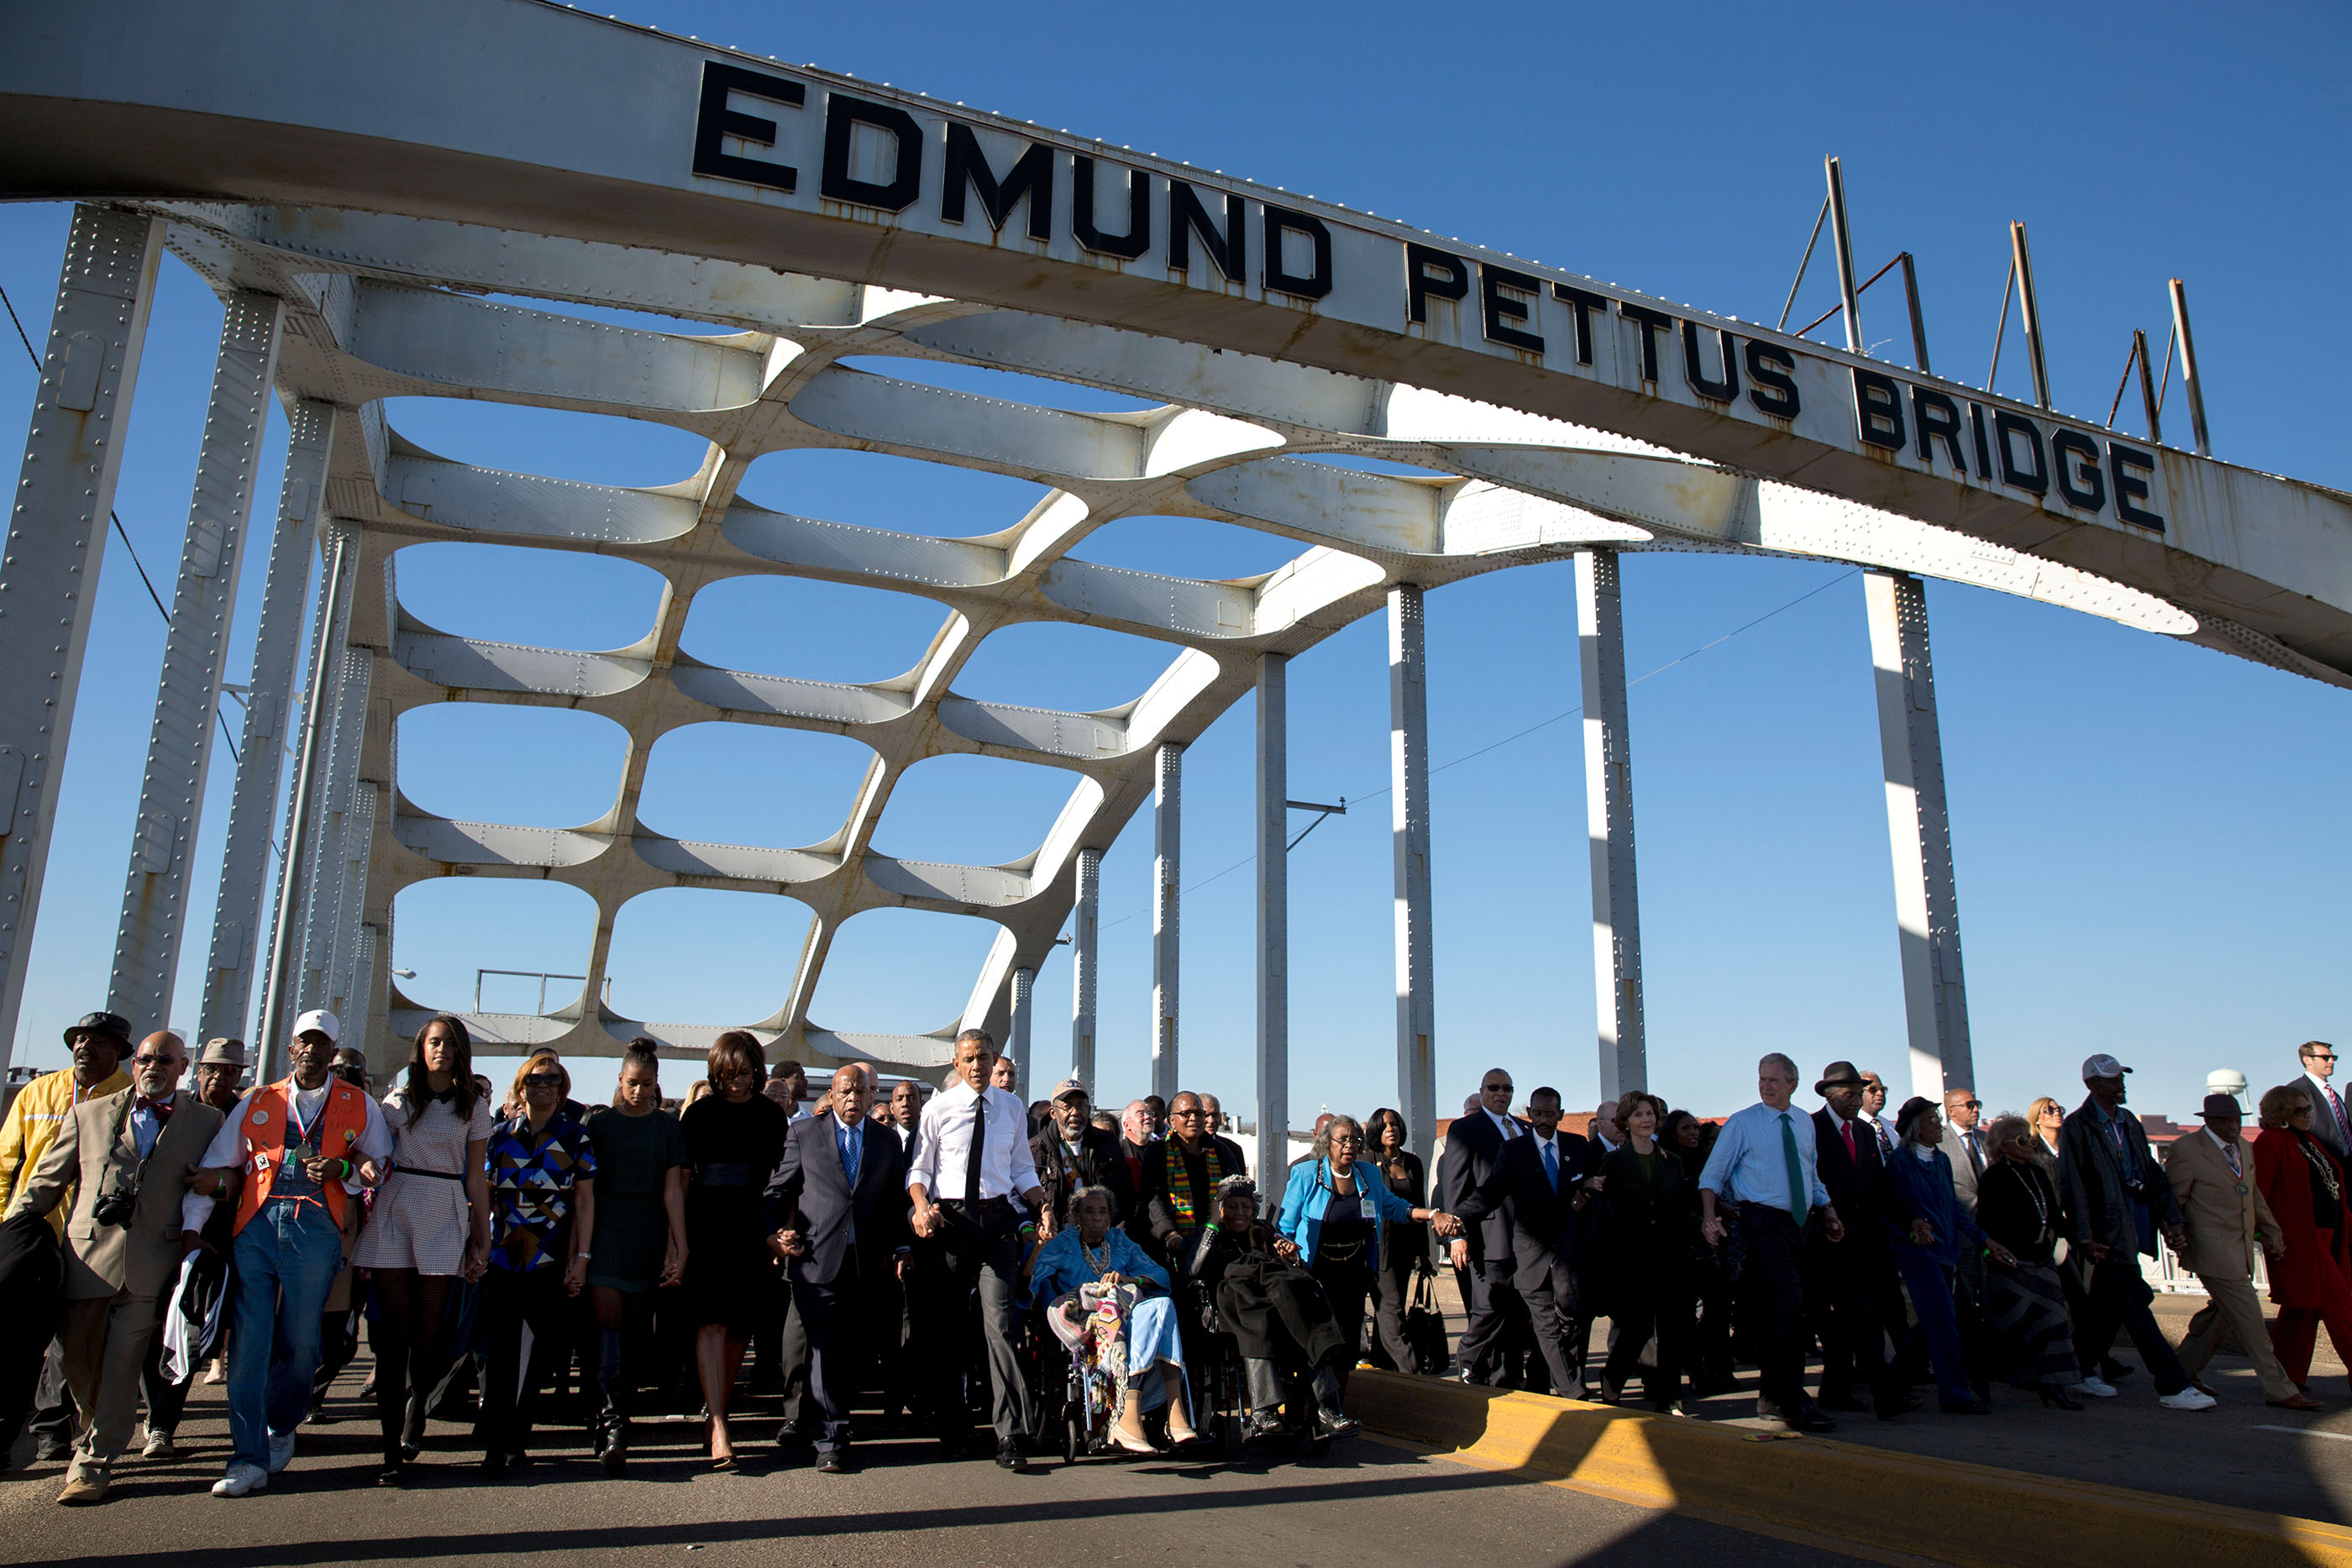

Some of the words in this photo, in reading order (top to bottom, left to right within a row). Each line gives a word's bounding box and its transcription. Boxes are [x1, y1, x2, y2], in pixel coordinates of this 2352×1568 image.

[692, 60, 1331, 301] EDMUND
[1405, 242, 1801, 420] PETTUS
[1852, 368, 2166, 533] BRIDGE
